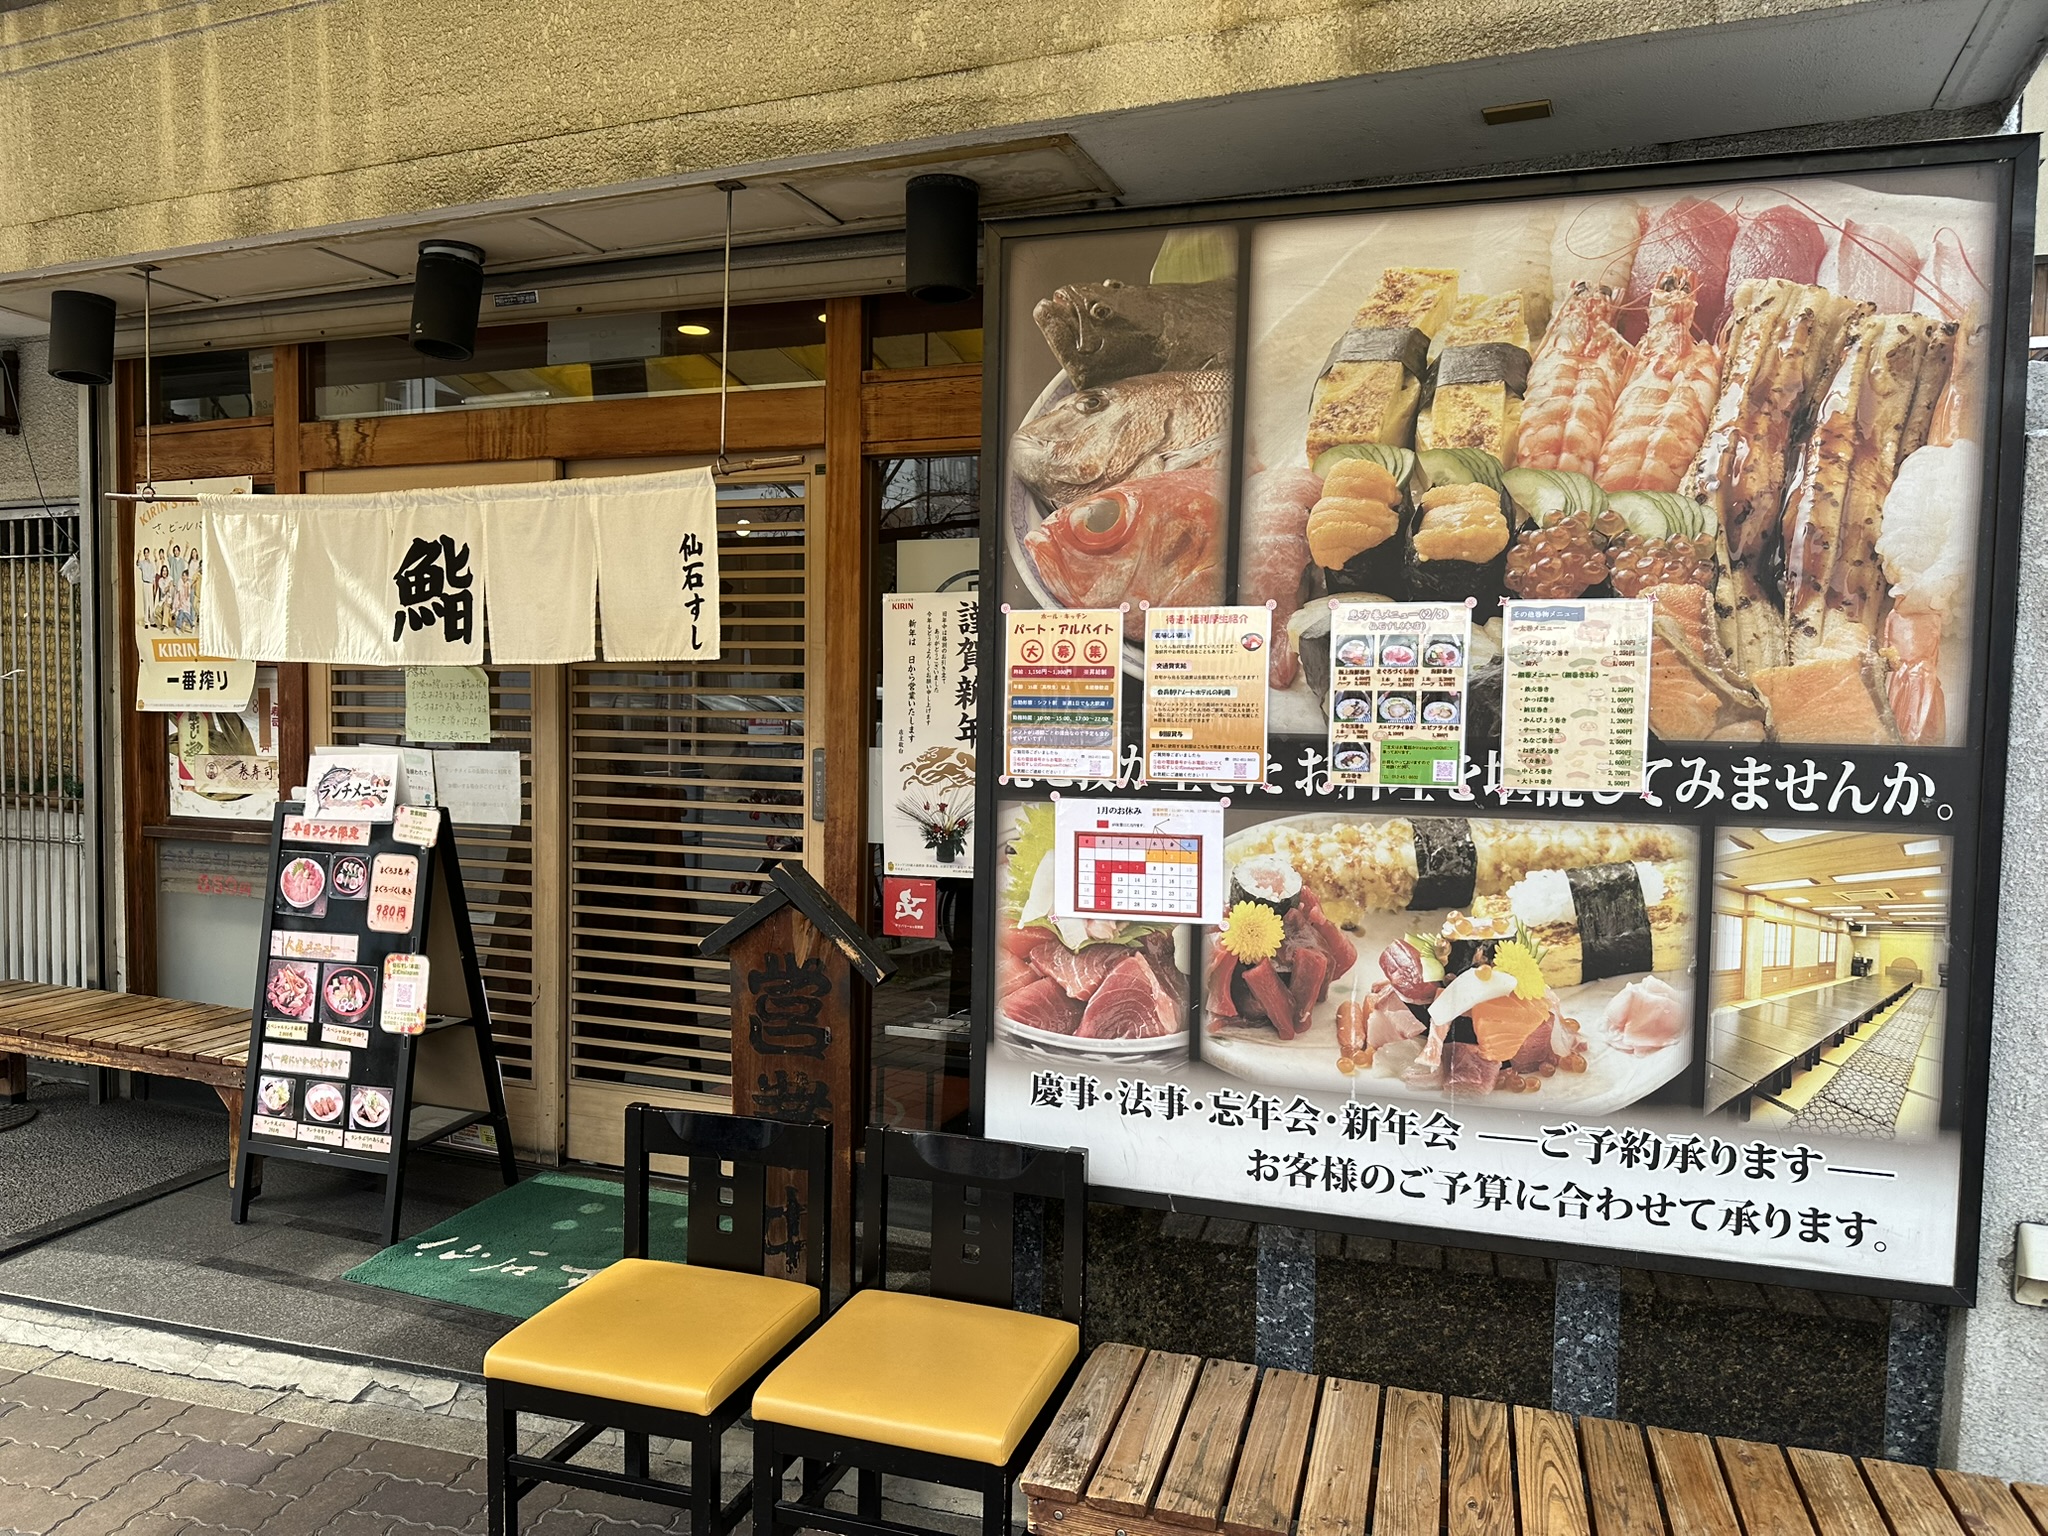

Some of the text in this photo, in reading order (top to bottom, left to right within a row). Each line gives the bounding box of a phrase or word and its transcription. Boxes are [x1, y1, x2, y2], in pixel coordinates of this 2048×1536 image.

[393, 534, 473, 644] 鮨
[679, 533, 705, 650] 仙石すし
[892, 602, 914, 610] KIRIN
[1513, 610, 1578, 618] その他巻物メニュー
[1166, 614, 1248, 624] 待遇・福利厚生紹介
[1014, 624, 1113, 635] パート・アルバイト
[158, 643, 198, 658] KIRIN
[167, 670, 229, 691] 一番搾り
[908, 619, 917, 743] 新年は 日から営業いたします
[954, 601, 978, 749] 謹賀新年
[239, 763, 273, 780] 巻寿司
[320, 783, 388, 799] ランチメニュー
[1096, 807, 1142, 815] 1月のお休み
[292, 822, 359, 839] 平日ランチ限定
[376, 905, 406, 919] 980円
[1030, 1071, 1461, 1151] 慶事・法事・忘年会・新年会
[1246, 1149, 1889, 1253] お客様のご予算に合わせて承ります。
